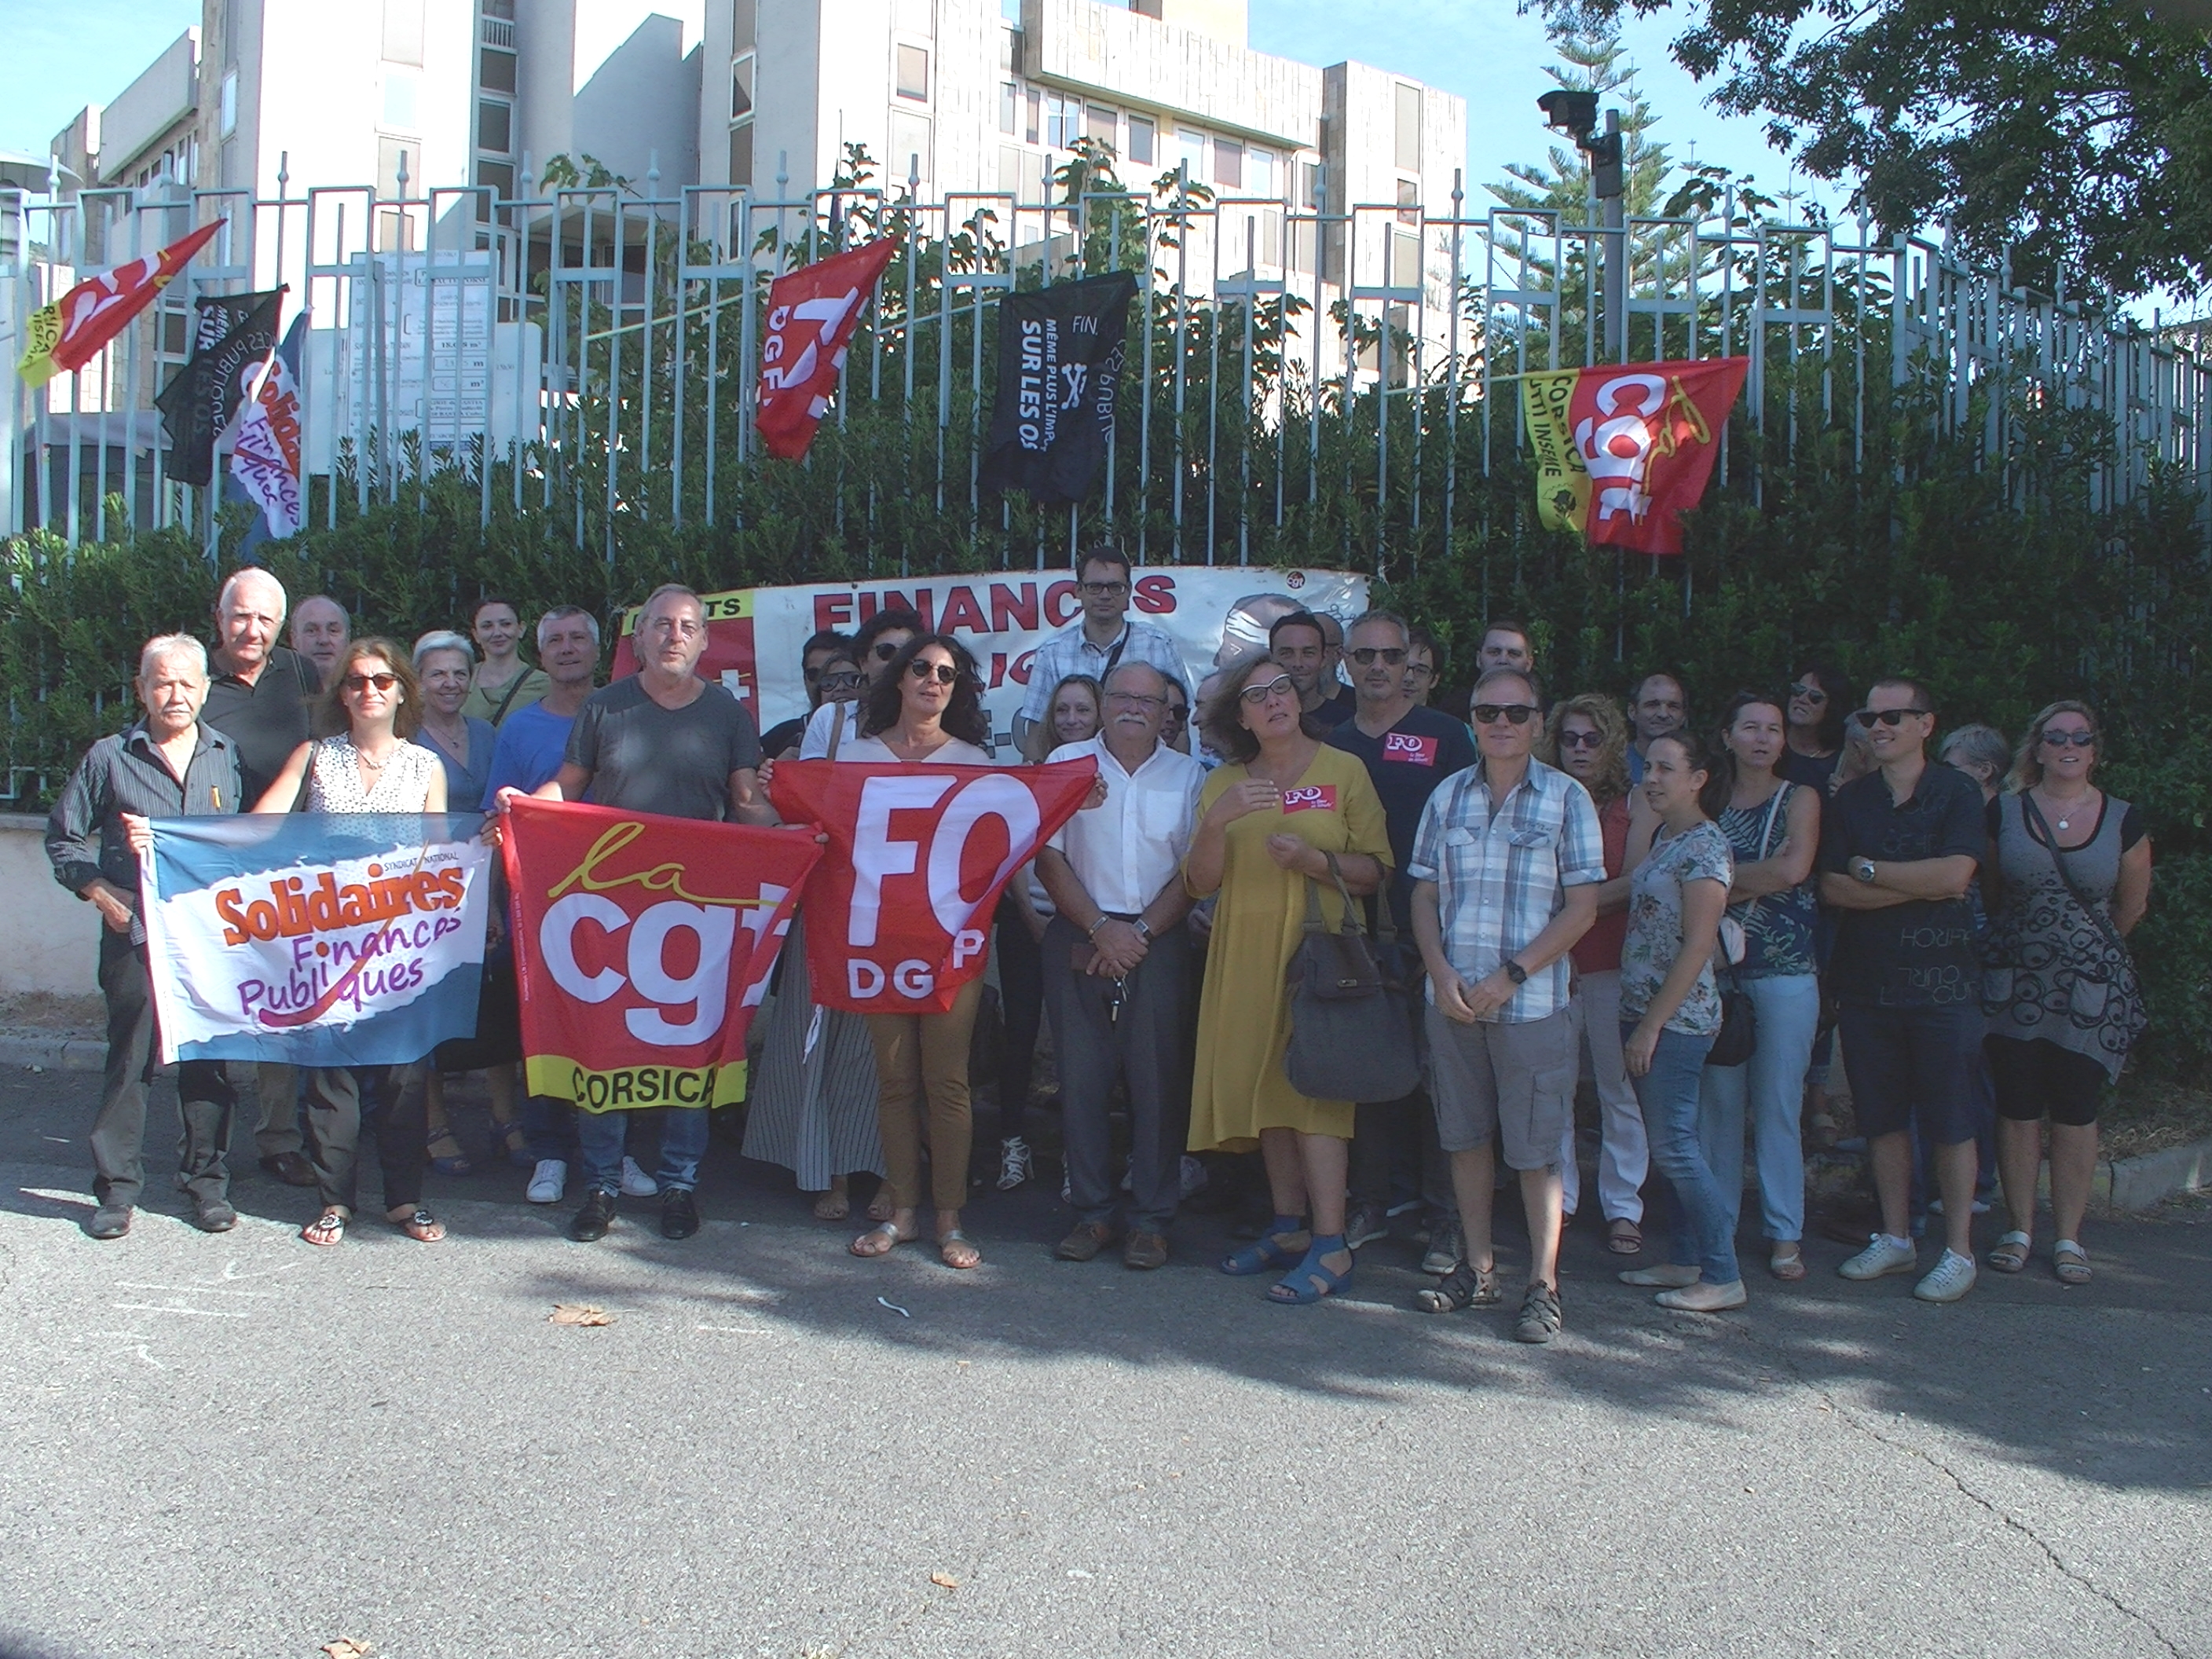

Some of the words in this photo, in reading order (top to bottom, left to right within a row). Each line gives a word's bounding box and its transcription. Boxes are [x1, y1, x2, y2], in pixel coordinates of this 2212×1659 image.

[1022, 320, 1042, 371] SUR
[1046, 319, 1059, 362] MÊME
[1020, 375, 1041, 419] LES
[1046, 365, 1057, 401] PLUS
[1534, 423, 1562, 477] INSEME
[814, 574, 1177, 635] FINANCS
[1387, 733, 1423, 752] FO
[1285, 786, 1322, 805] FO
[384, 858, 418, 872] SYNDICAT
[423, 851, 460, 864] NATIONAL
[848, 773, 1041, 947] FO
[215, 862, 467, 947] Solidaires
[292, 906, 462, 972] Finances
[539, 882, 791, 1047] cgt
[237, 958, 423, 1016] Publiques
[573, 1065, 716, 1109] CORSICA
